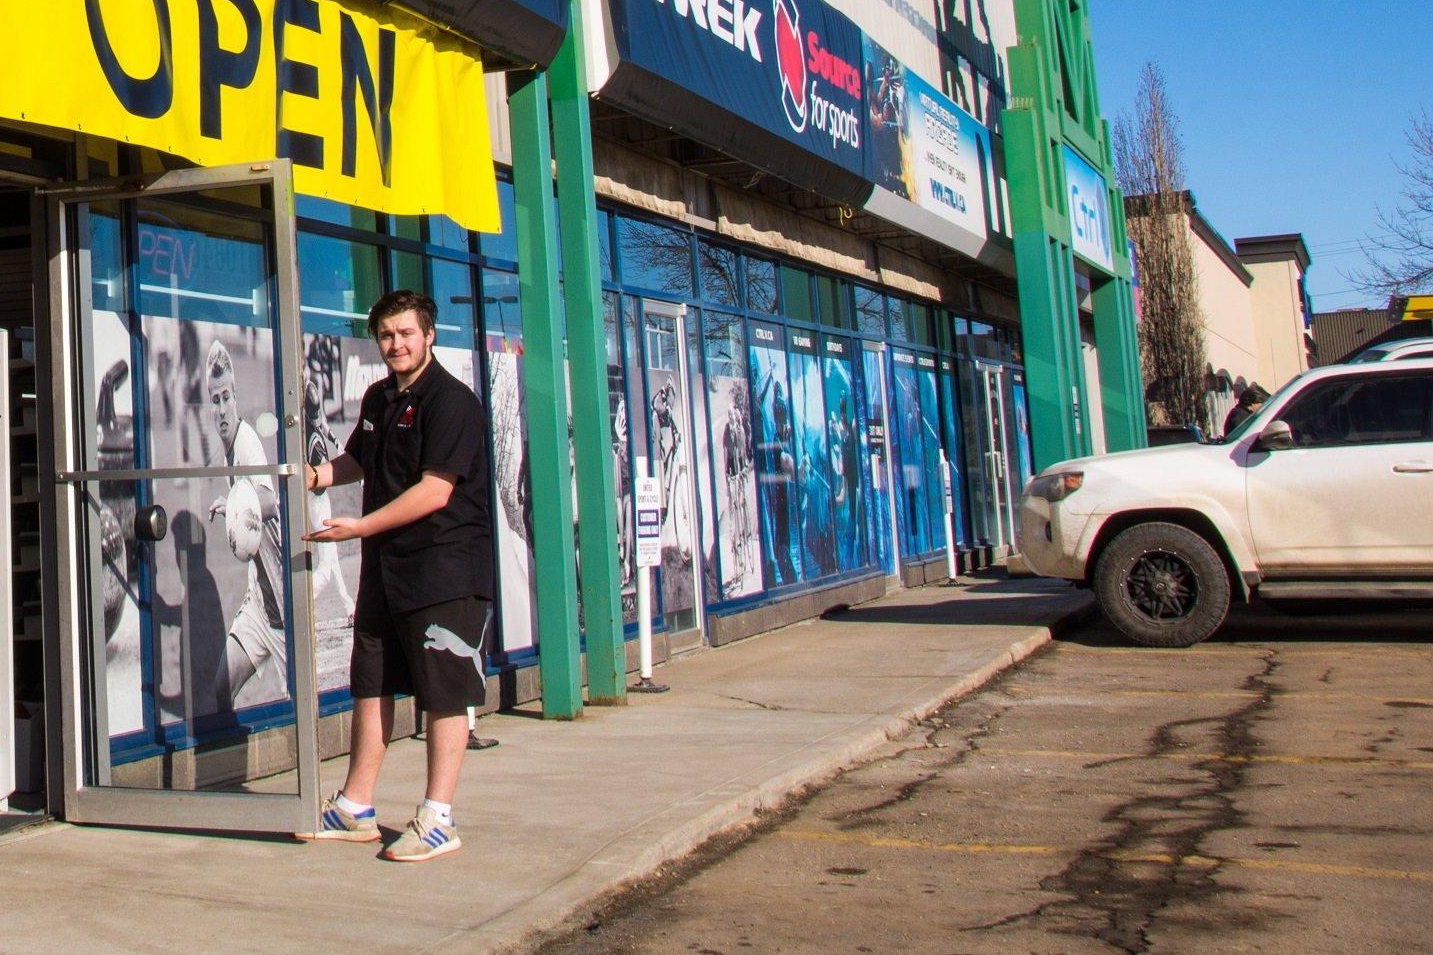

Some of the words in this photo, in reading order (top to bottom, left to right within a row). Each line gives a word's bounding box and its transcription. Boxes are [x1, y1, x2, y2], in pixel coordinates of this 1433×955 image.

[807, 31, 862, 100] Source
[810, 80, 831, 132] for
[829, 101, 860, 149] sports
[139, 229, 195, 278] PEN
